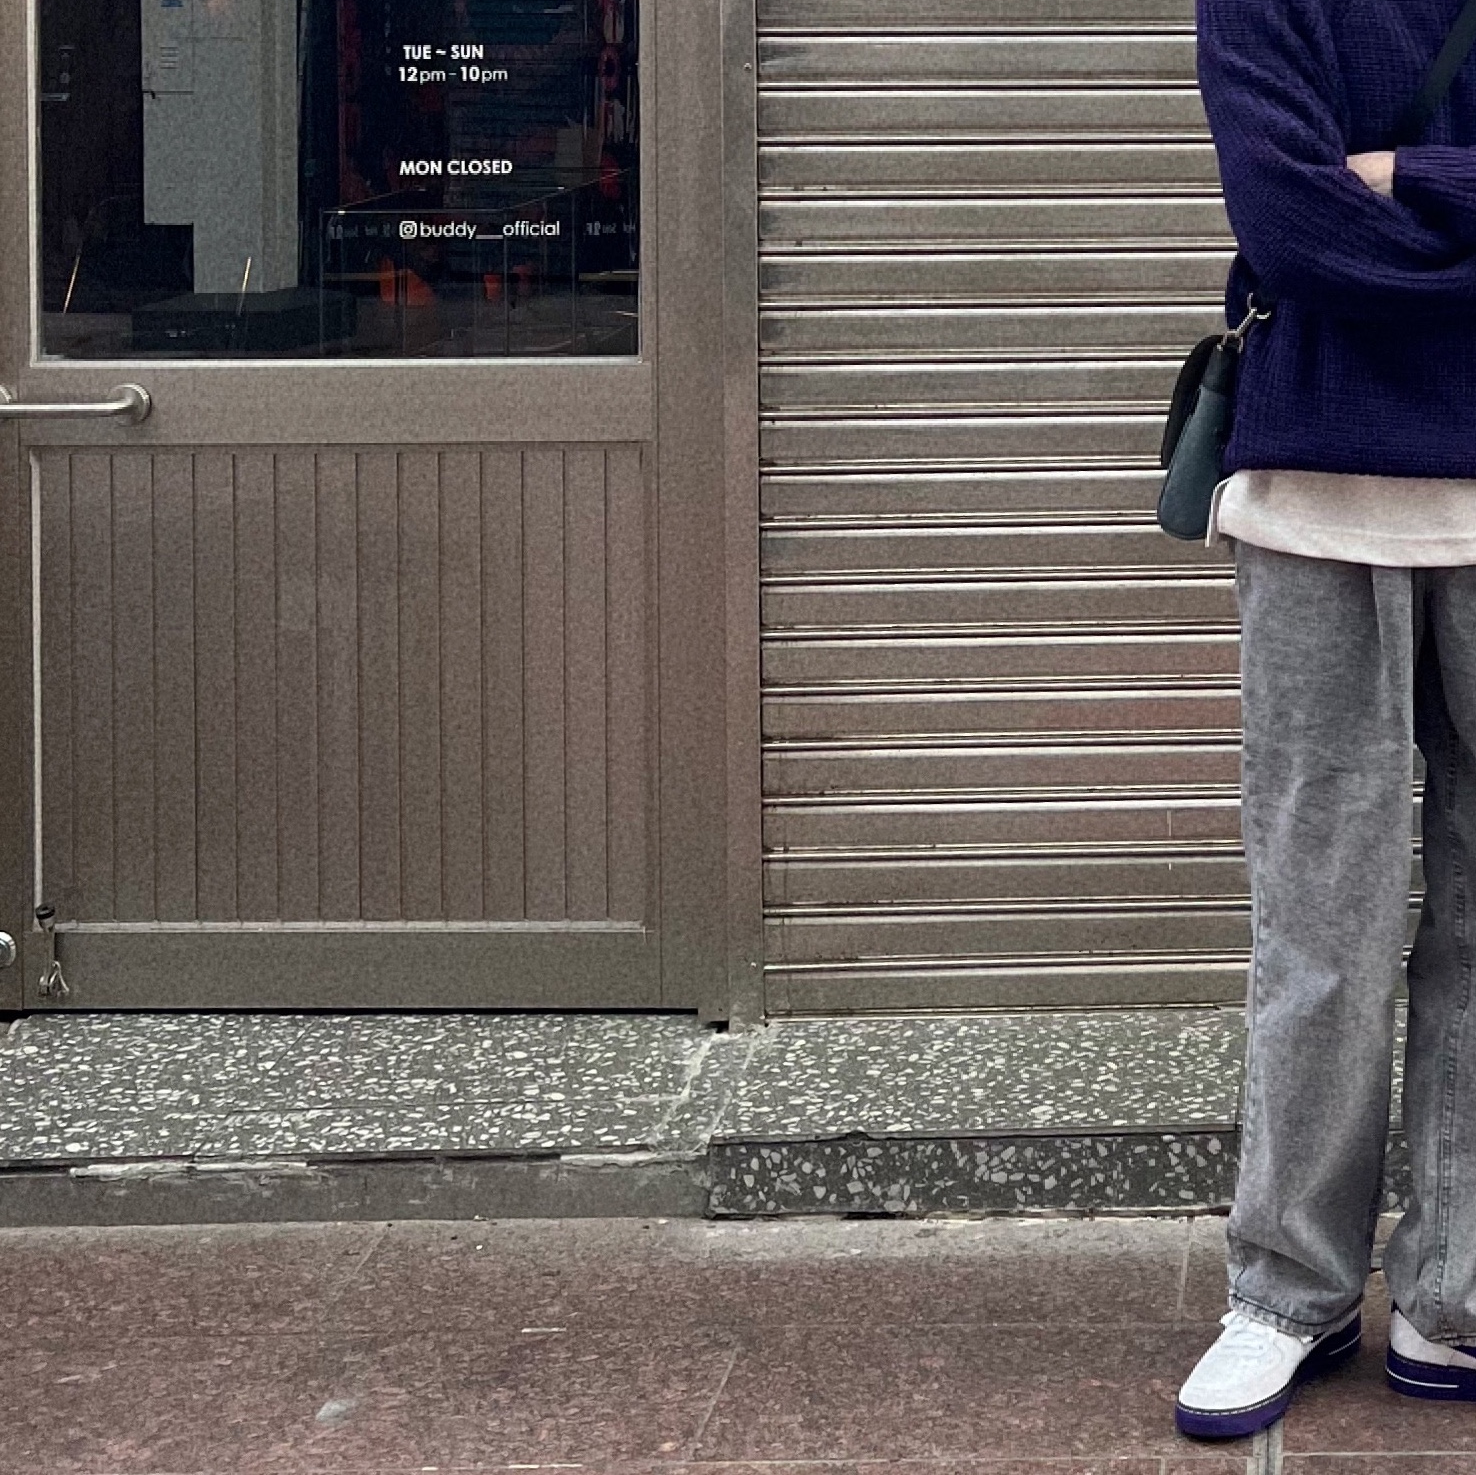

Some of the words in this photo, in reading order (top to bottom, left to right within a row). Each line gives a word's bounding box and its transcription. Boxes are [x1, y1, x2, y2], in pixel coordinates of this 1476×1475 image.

[402, 44, 432, 60] TUE
[450, 44, 484, 60] SUN
[399, 160, 442, 176] MON
[447, 159, 513, 176] CLOSED
